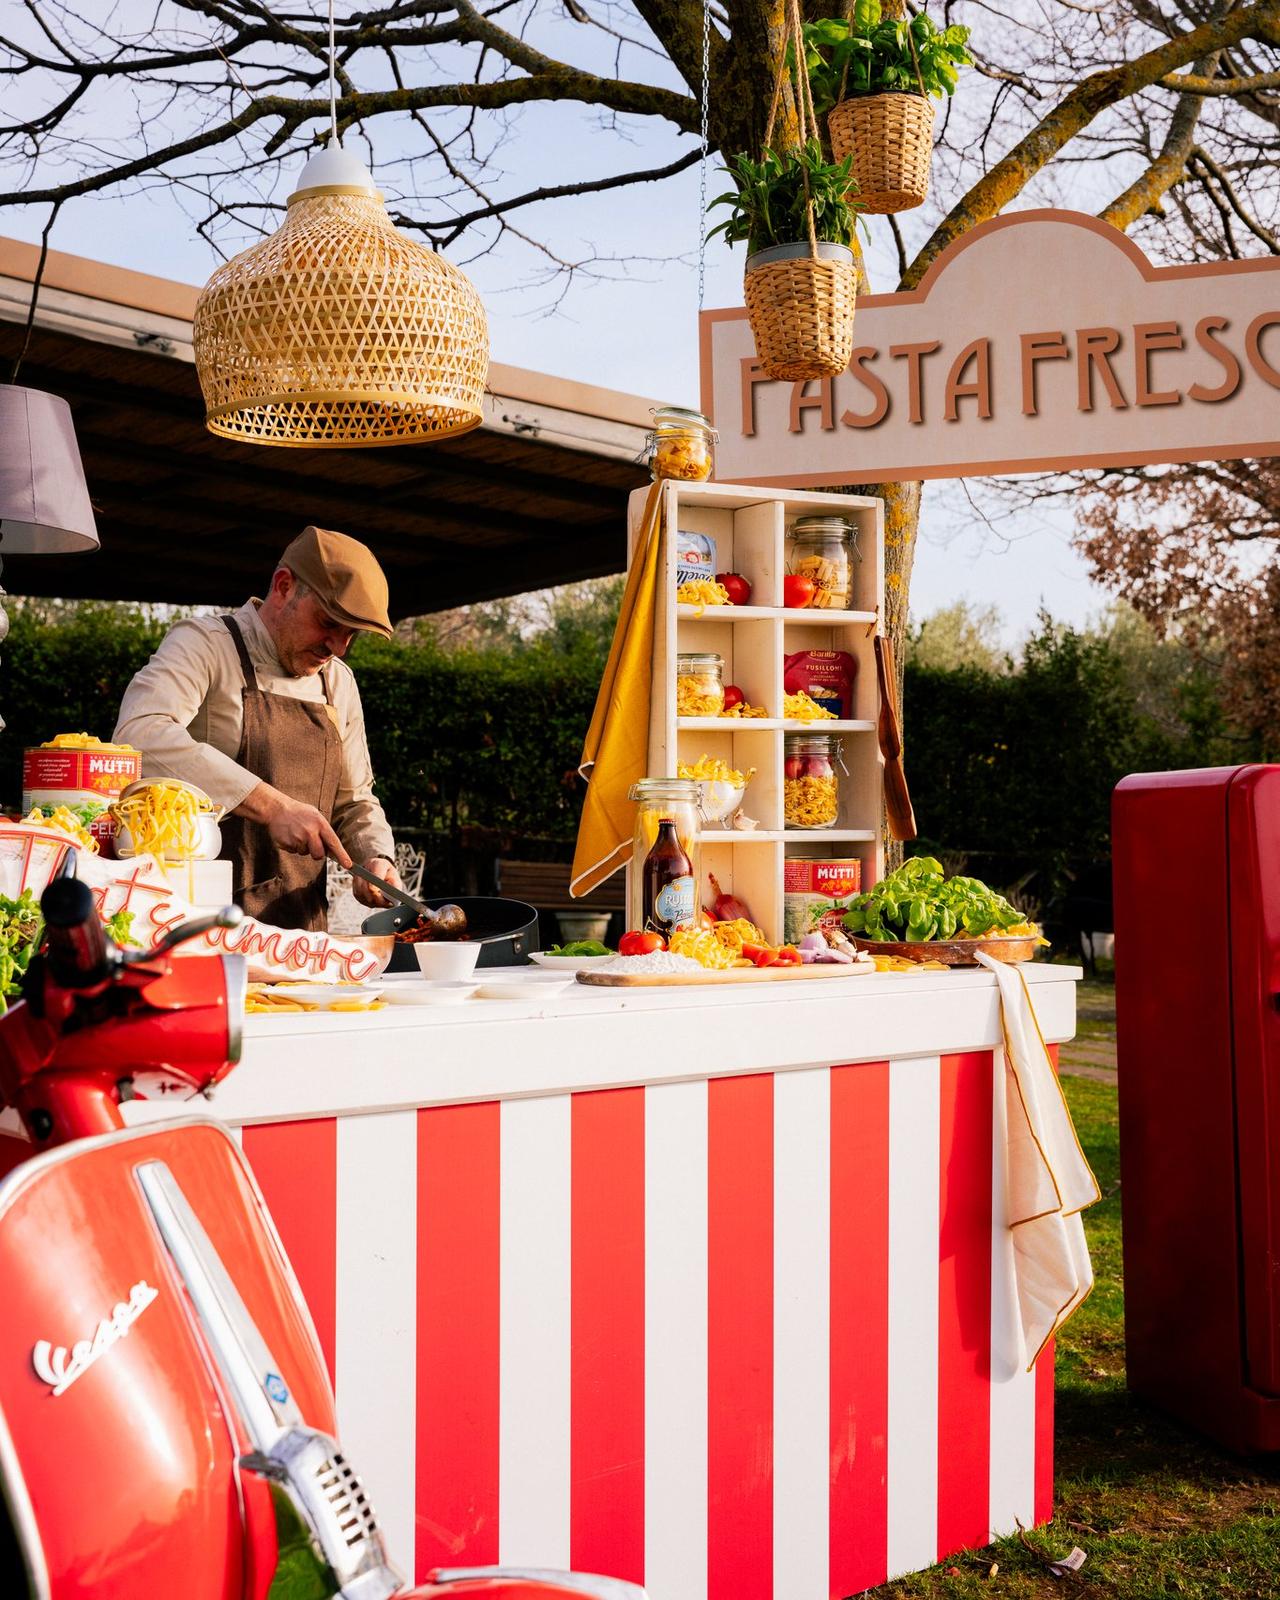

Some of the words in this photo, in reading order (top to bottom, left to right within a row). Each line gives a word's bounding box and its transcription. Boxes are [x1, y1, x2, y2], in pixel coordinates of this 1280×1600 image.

[89, 759, 135, 774] MUTTI
[89, 822, 117, 834] PEL
[817, 868, 854, 879] MUTTI
[818, 917, 846, 928] PEL
[203, 919, 377, 981] amore
[33, 1280, 159, 1396] Vespa
